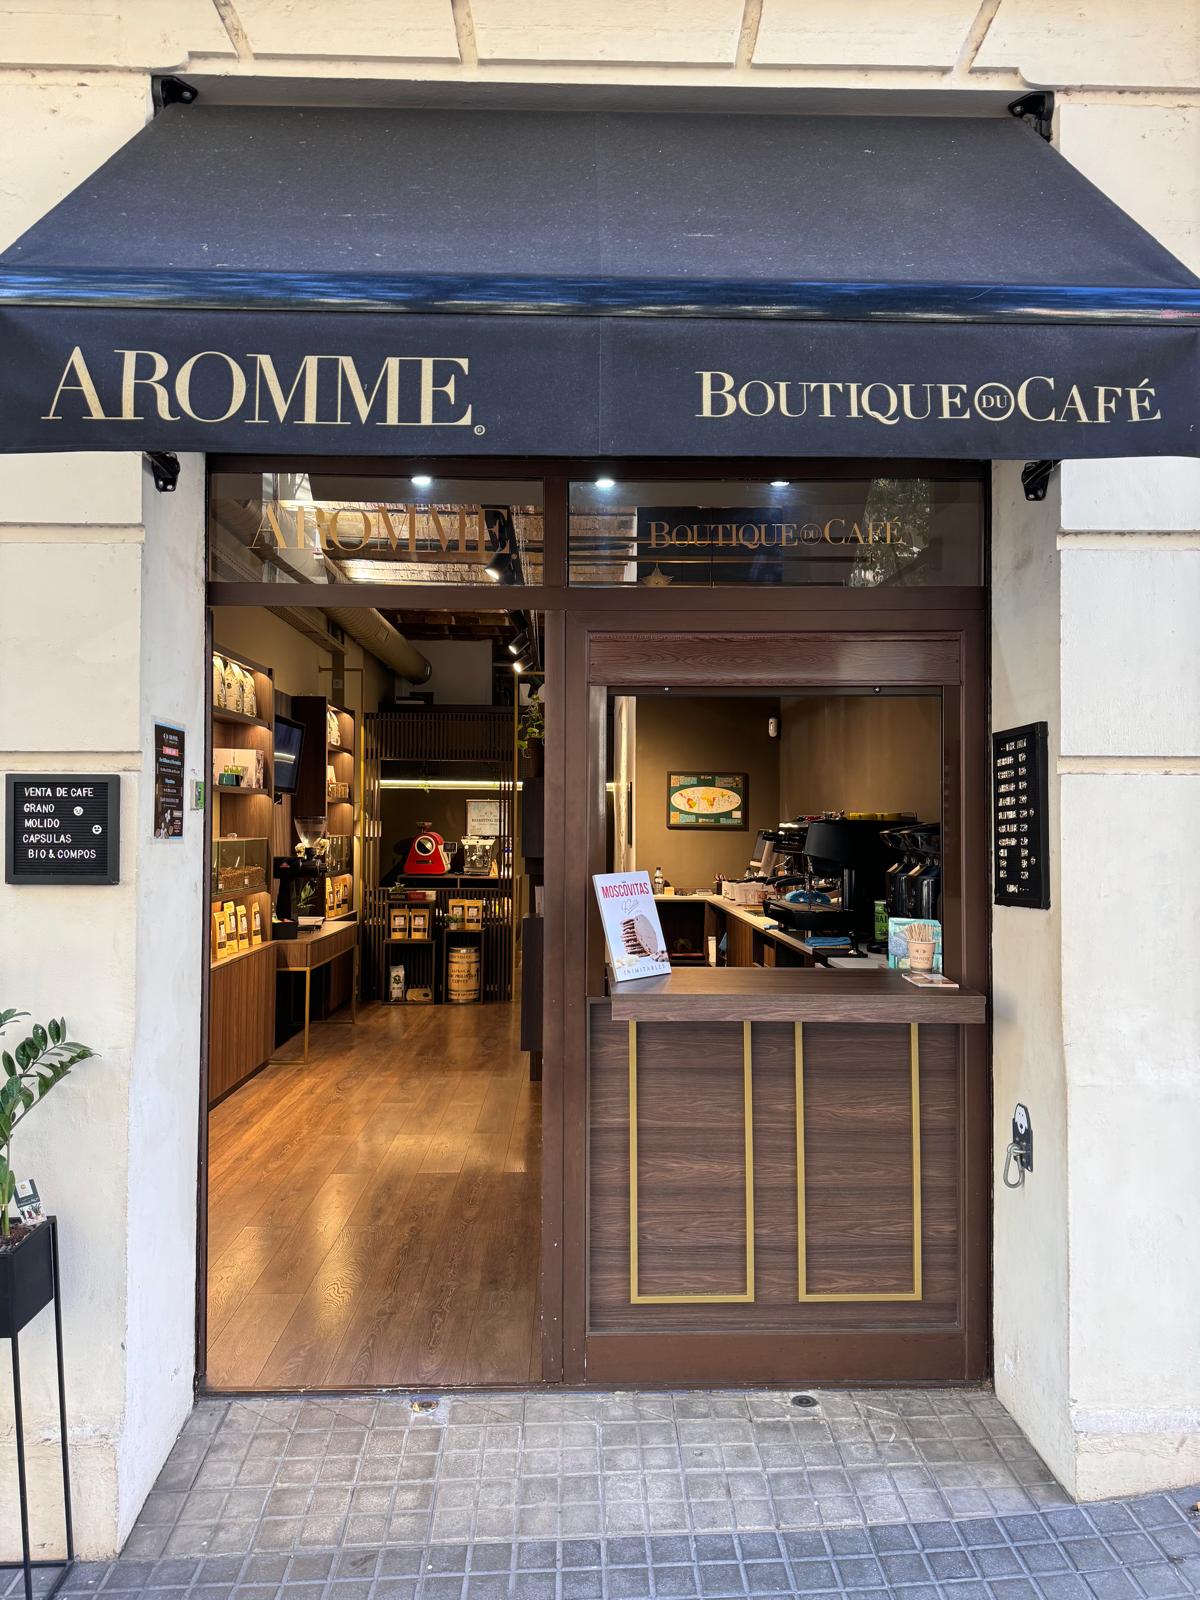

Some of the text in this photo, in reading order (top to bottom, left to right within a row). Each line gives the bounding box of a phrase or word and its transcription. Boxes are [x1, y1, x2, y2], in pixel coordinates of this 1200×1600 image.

[41, 346, 472, 426] AROMME
[695, 371, 970, 425] BOUTIQUE
[1017, 376, 1162, 424] CAFÉ
[248, 503, 510, 553] AROMME
[648, 521, 798, 549] BOUTIQUE
[824, 517, 906, 545] CAFÉ
[24, 787, 94, 797] VENTA DE CAFE
[23, 803, 55, 813] GRANO
[24, 818, 60, 828] MOLIDO
[22, 834, 72, 843] CAPSULAS
[28, 848, 96, 859] BIO & COMPOS
[601, 882, 650, 898] MOSCOVITAS
